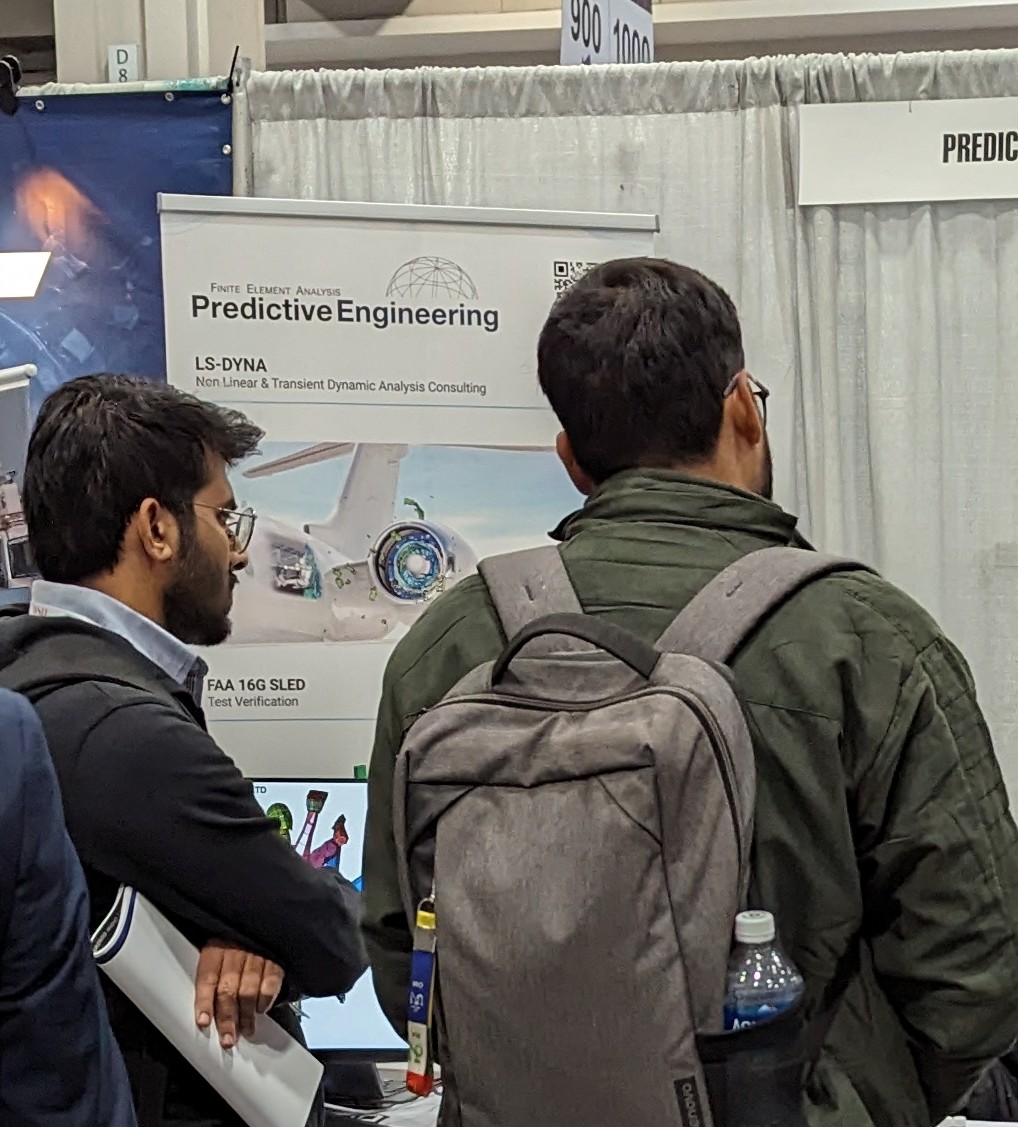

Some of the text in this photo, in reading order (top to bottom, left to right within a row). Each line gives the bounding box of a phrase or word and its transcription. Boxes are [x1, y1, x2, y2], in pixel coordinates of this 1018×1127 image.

[570, 0, 601, 53] 900
[613, 18, 650, 63] 1000
[116, 49, 129, 65] D
[118, 68, 128, 83] 8
[191, 294, 499, 333] Predictive Engineering
[195, 356, 268, 373] LS-DYNA
[223, 377, 258, 389] Linear
[260, 377, 269, 389] &
[272, 377, 324, 391] Transient
[327, 379, 376, 393] Dynamic
[378, 380, 425, 395] Analysis
[428, 381, 487, 397] Consulting
[207, 678, 306, 692] FAA 16G SLED
[208, 695, 299, 708] Test Verification
